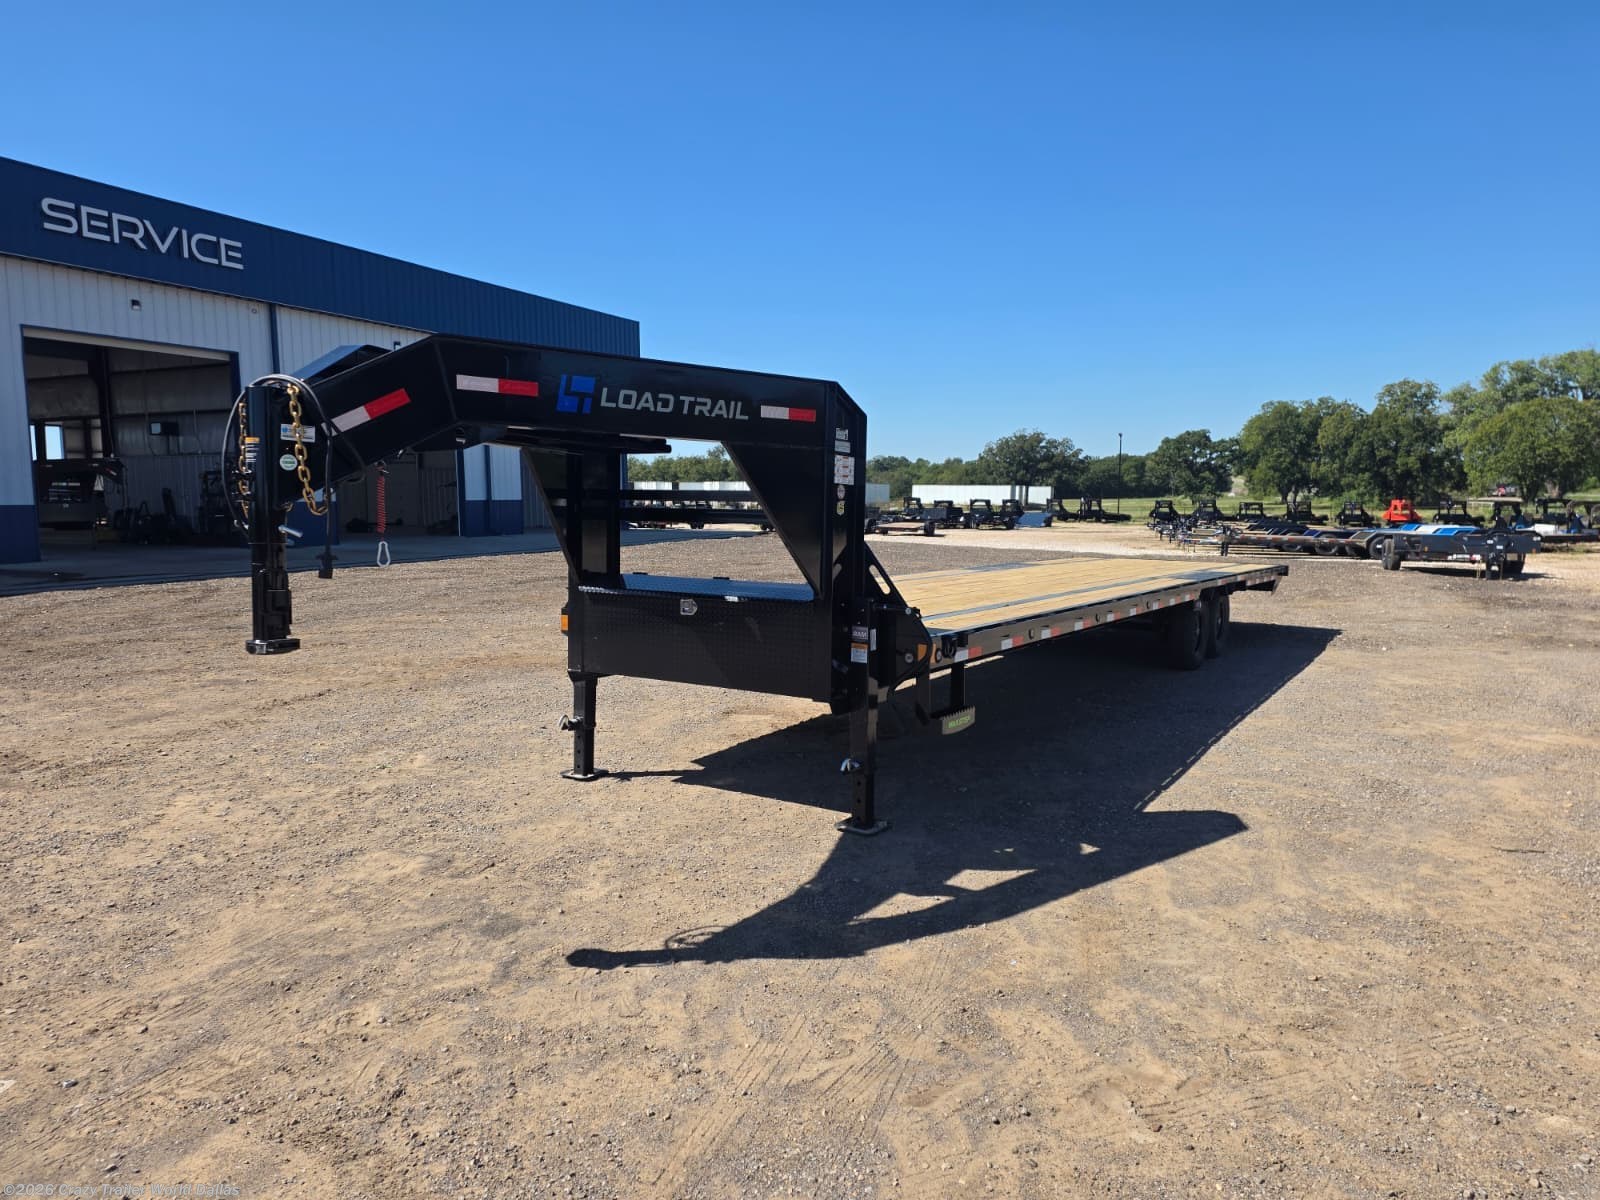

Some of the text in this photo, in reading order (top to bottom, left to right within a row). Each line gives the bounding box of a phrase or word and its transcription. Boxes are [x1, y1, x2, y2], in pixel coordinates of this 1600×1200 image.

[41, 197, 244, 270] SERVICE
[600, 387, 749, 420] LOAD TRAIL
